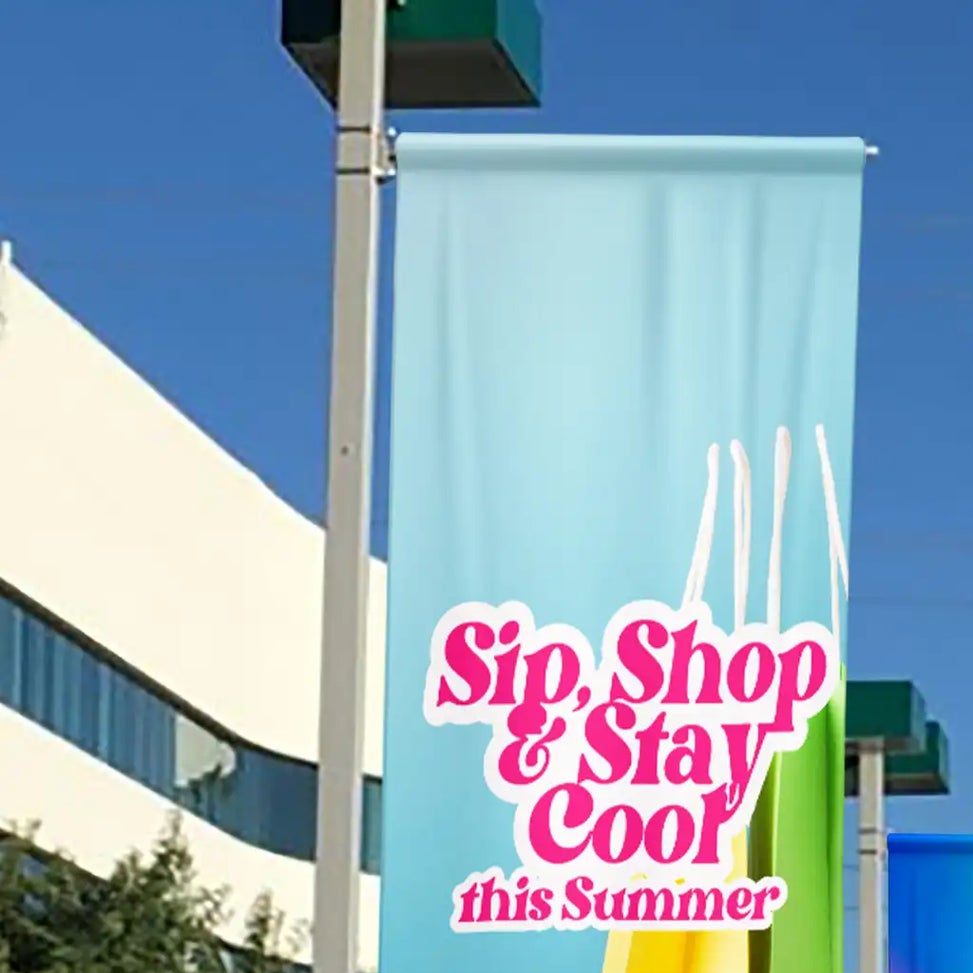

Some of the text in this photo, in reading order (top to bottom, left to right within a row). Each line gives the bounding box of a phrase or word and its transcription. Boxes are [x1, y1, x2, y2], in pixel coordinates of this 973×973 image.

[436, 619, 827, 733] Sip, Shop
[498, 702, 770, 824] & Stay
[529, 783, 730, 864] Cool
[458, 876, 781, 923] this Summer
